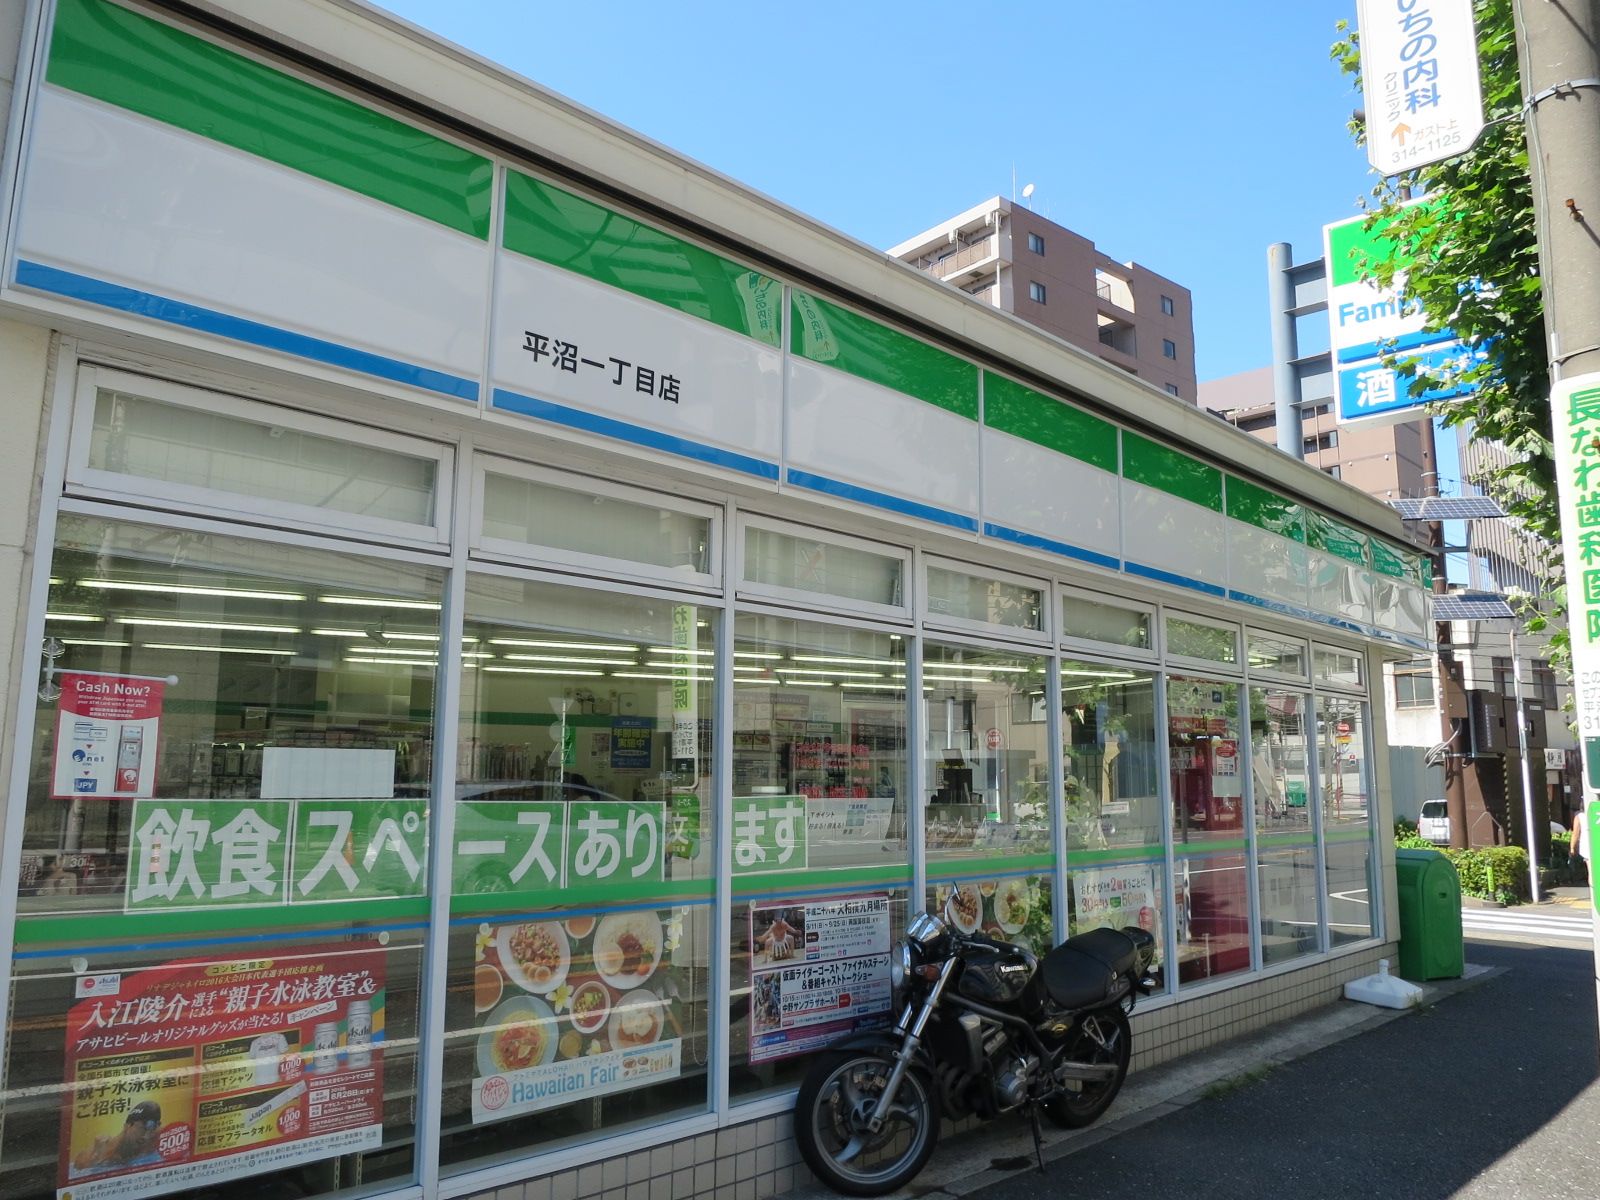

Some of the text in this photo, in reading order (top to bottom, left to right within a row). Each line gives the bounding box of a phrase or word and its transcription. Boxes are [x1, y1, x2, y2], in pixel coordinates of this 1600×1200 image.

[1384, 72, 1400, 122] クリニック
[1391, 131, 1462, 164] 314-1125
[1338, 289, 1425, 328] Famiy
[522, 330, 681, 404] 平沼一丁目店
[1356, 368, 1397, 408] 酒
[76, 681, 151, 697] Cash Now?
[77, 781, 94, 789] JPY
[783, 956, 889, 982] 仮面ライダーゴースト ファイナルステージ
[801, 972, 873, 990] &番組キャストトークショー
[79, 993, 190, 1032] 入江陵介
[191, 991, 217, 1008] 選手
[189, 1005, 214, 1020] による
[511, 1073, 585, 1103] Hawaiian
[590, 1065, 620, 1087] Fair
[76, 1097, 132, 1119] ご招待!
